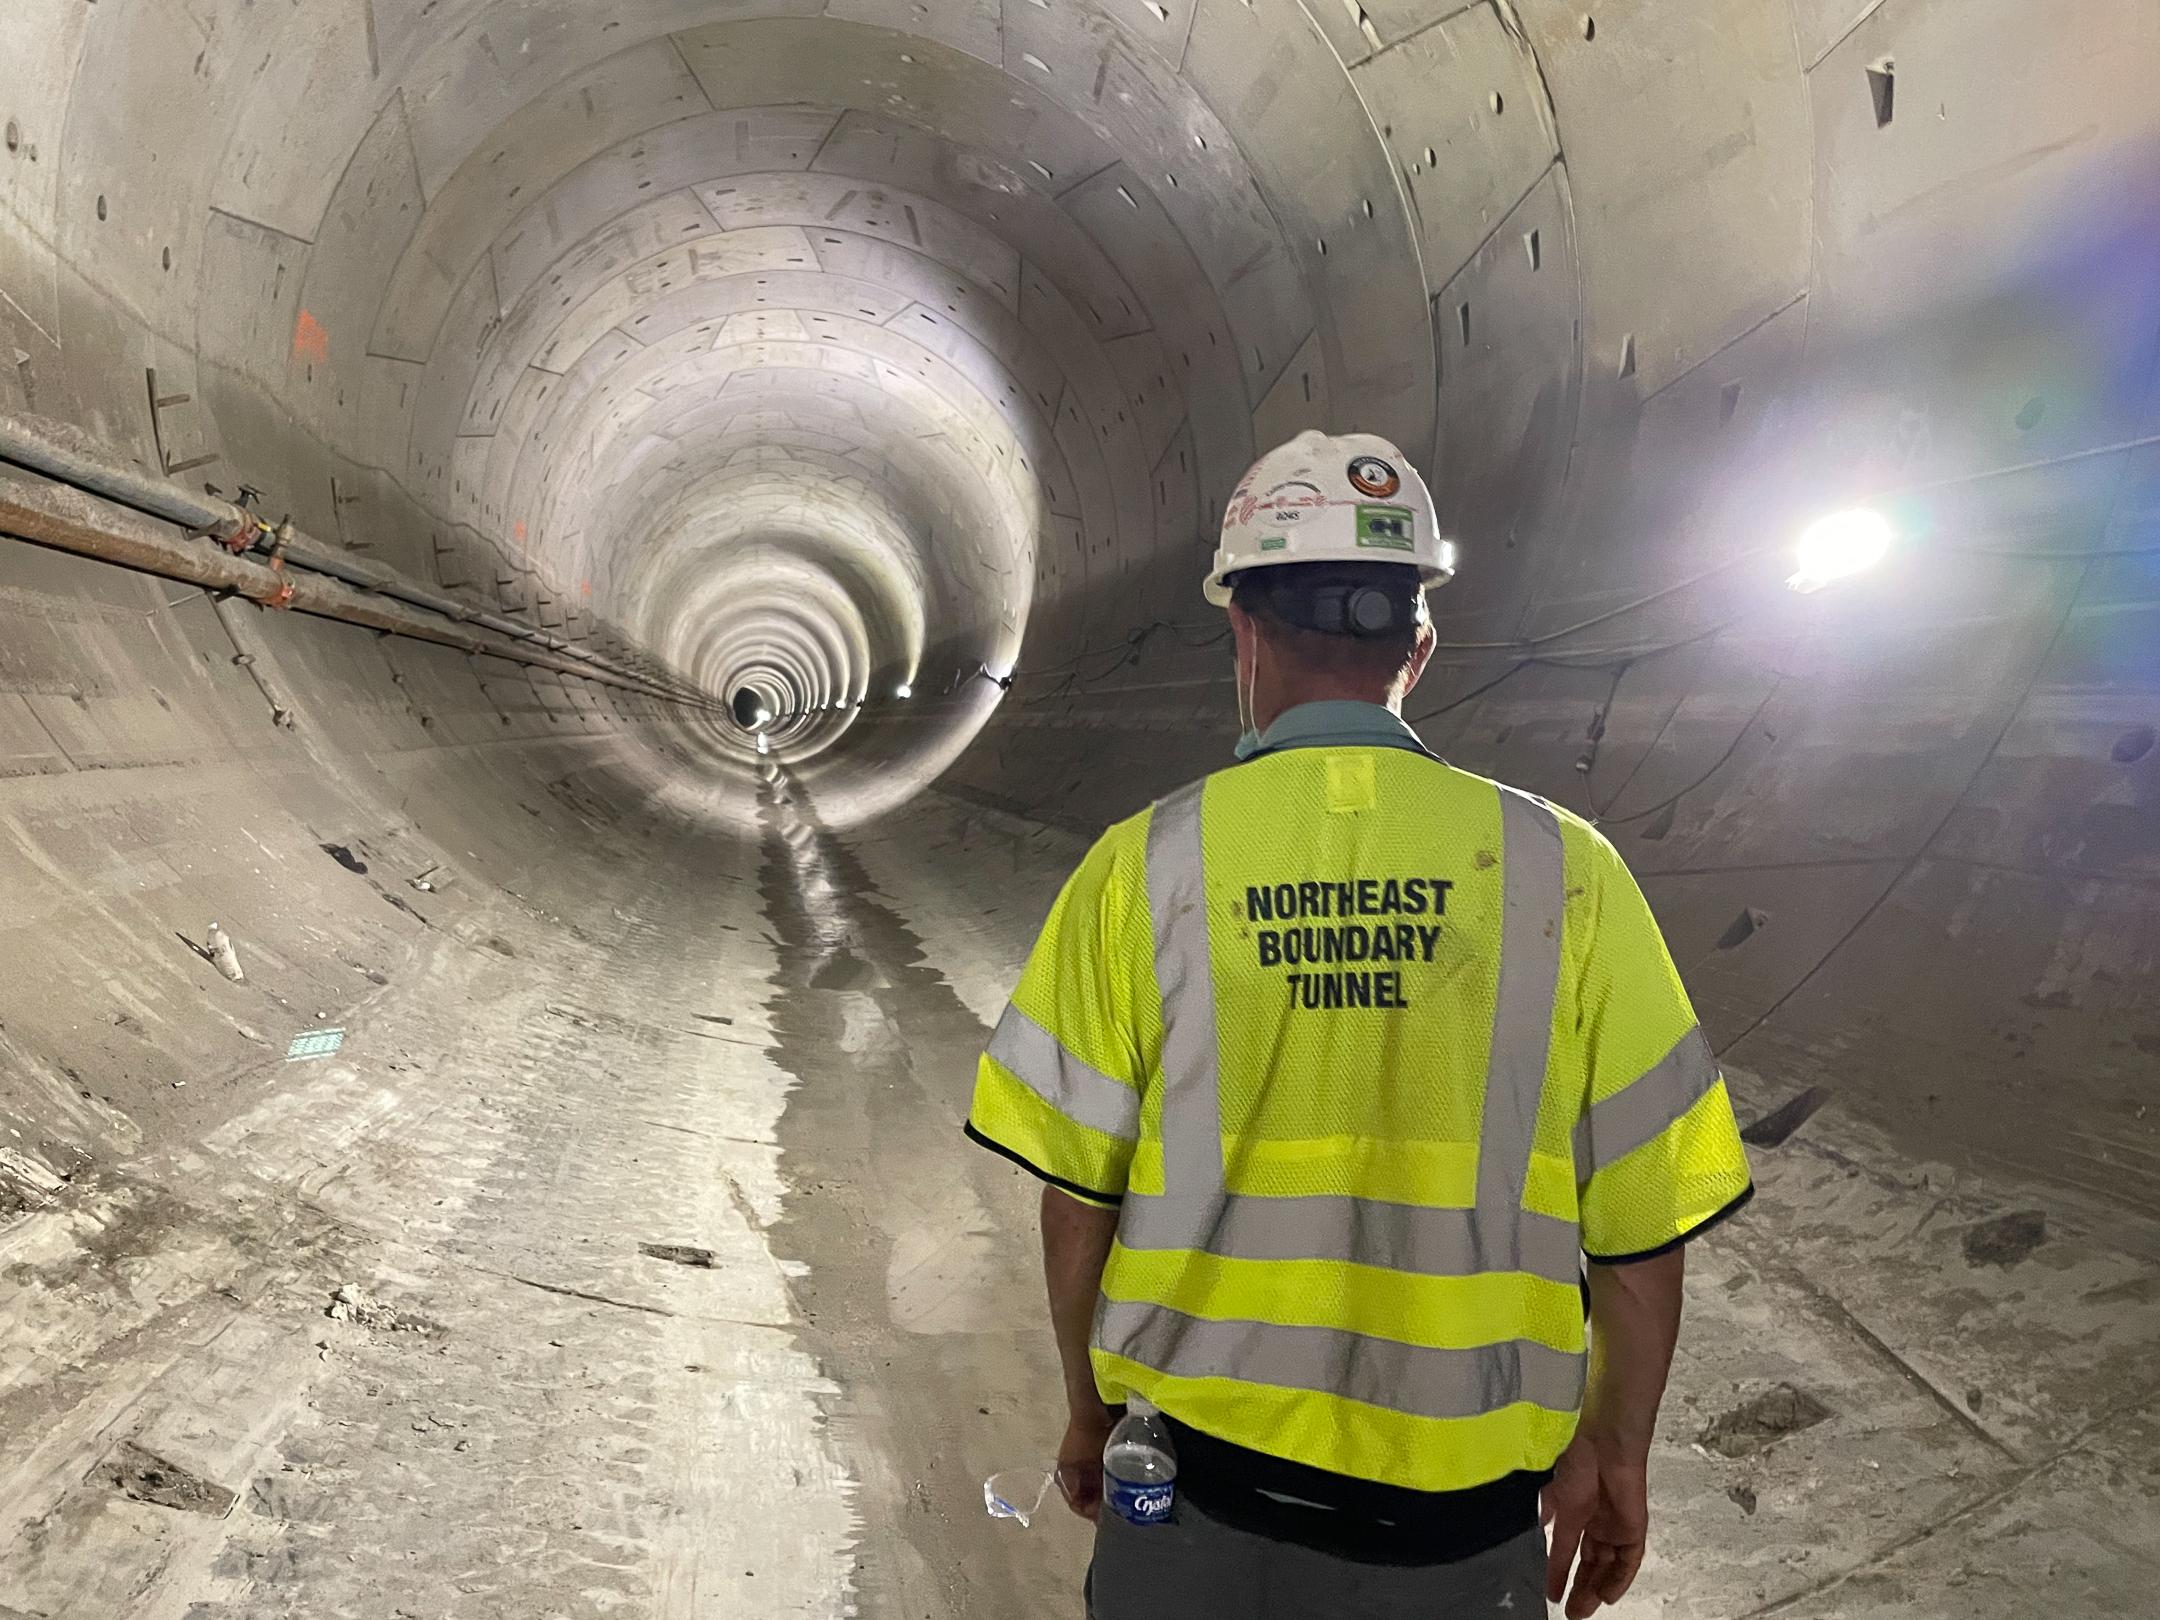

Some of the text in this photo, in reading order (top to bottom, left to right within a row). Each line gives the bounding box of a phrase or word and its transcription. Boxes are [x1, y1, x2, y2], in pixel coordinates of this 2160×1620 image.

[1246, 878, 1453, 921] NORTHEAST
[1258, 924, 1441, 967] BOUNDARY
[1287, 971, 1408, 1009] TUNNEL
